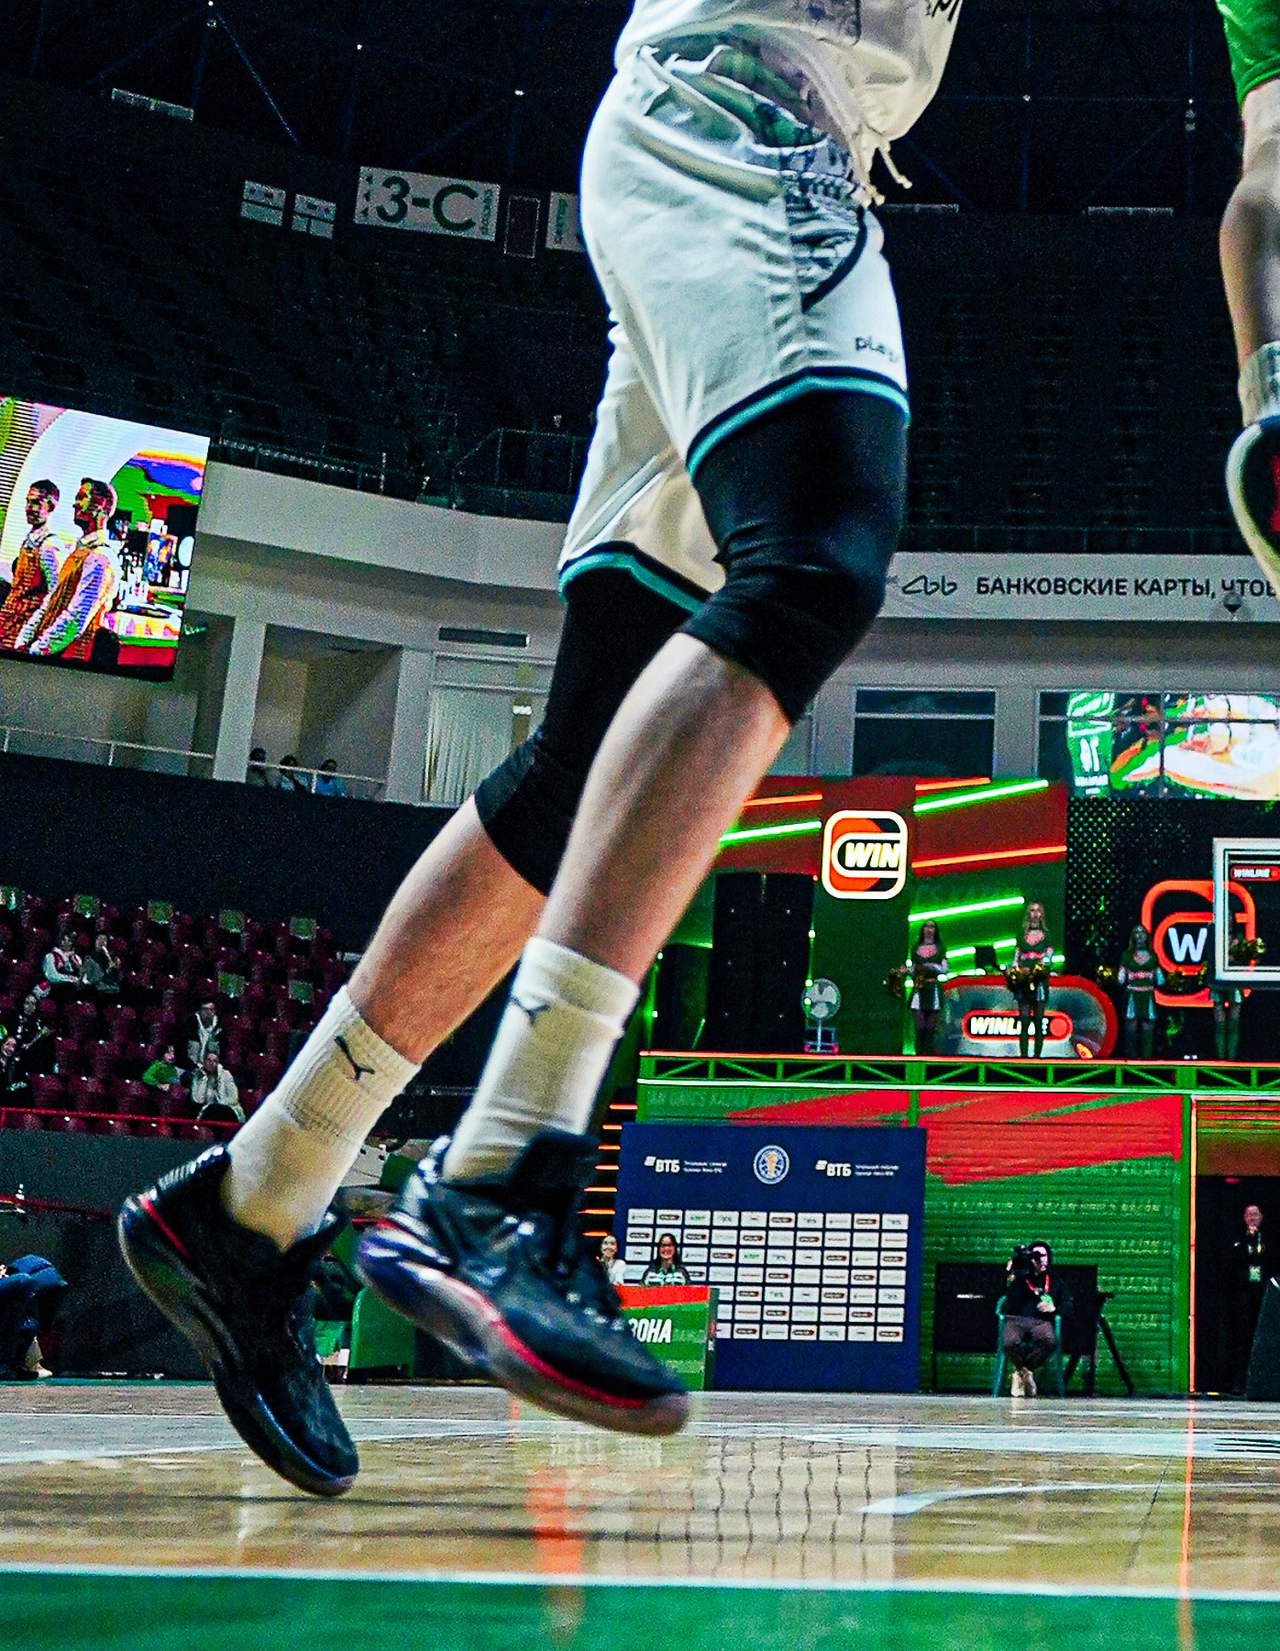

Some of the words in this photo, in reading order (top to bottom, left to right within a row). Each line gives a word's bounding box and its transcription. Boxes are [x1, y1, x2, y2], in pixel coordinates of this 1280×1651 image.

[975, 575, 1129, 597] БАНКОВСКИЕ
[1133, 575, 1216, 601] КАРТЫ,
[844, 842, 901, 869] WIN
[655, 1159, 681, 1174] ВТБ
[826, 1163, 853, 1178] ВТБ
